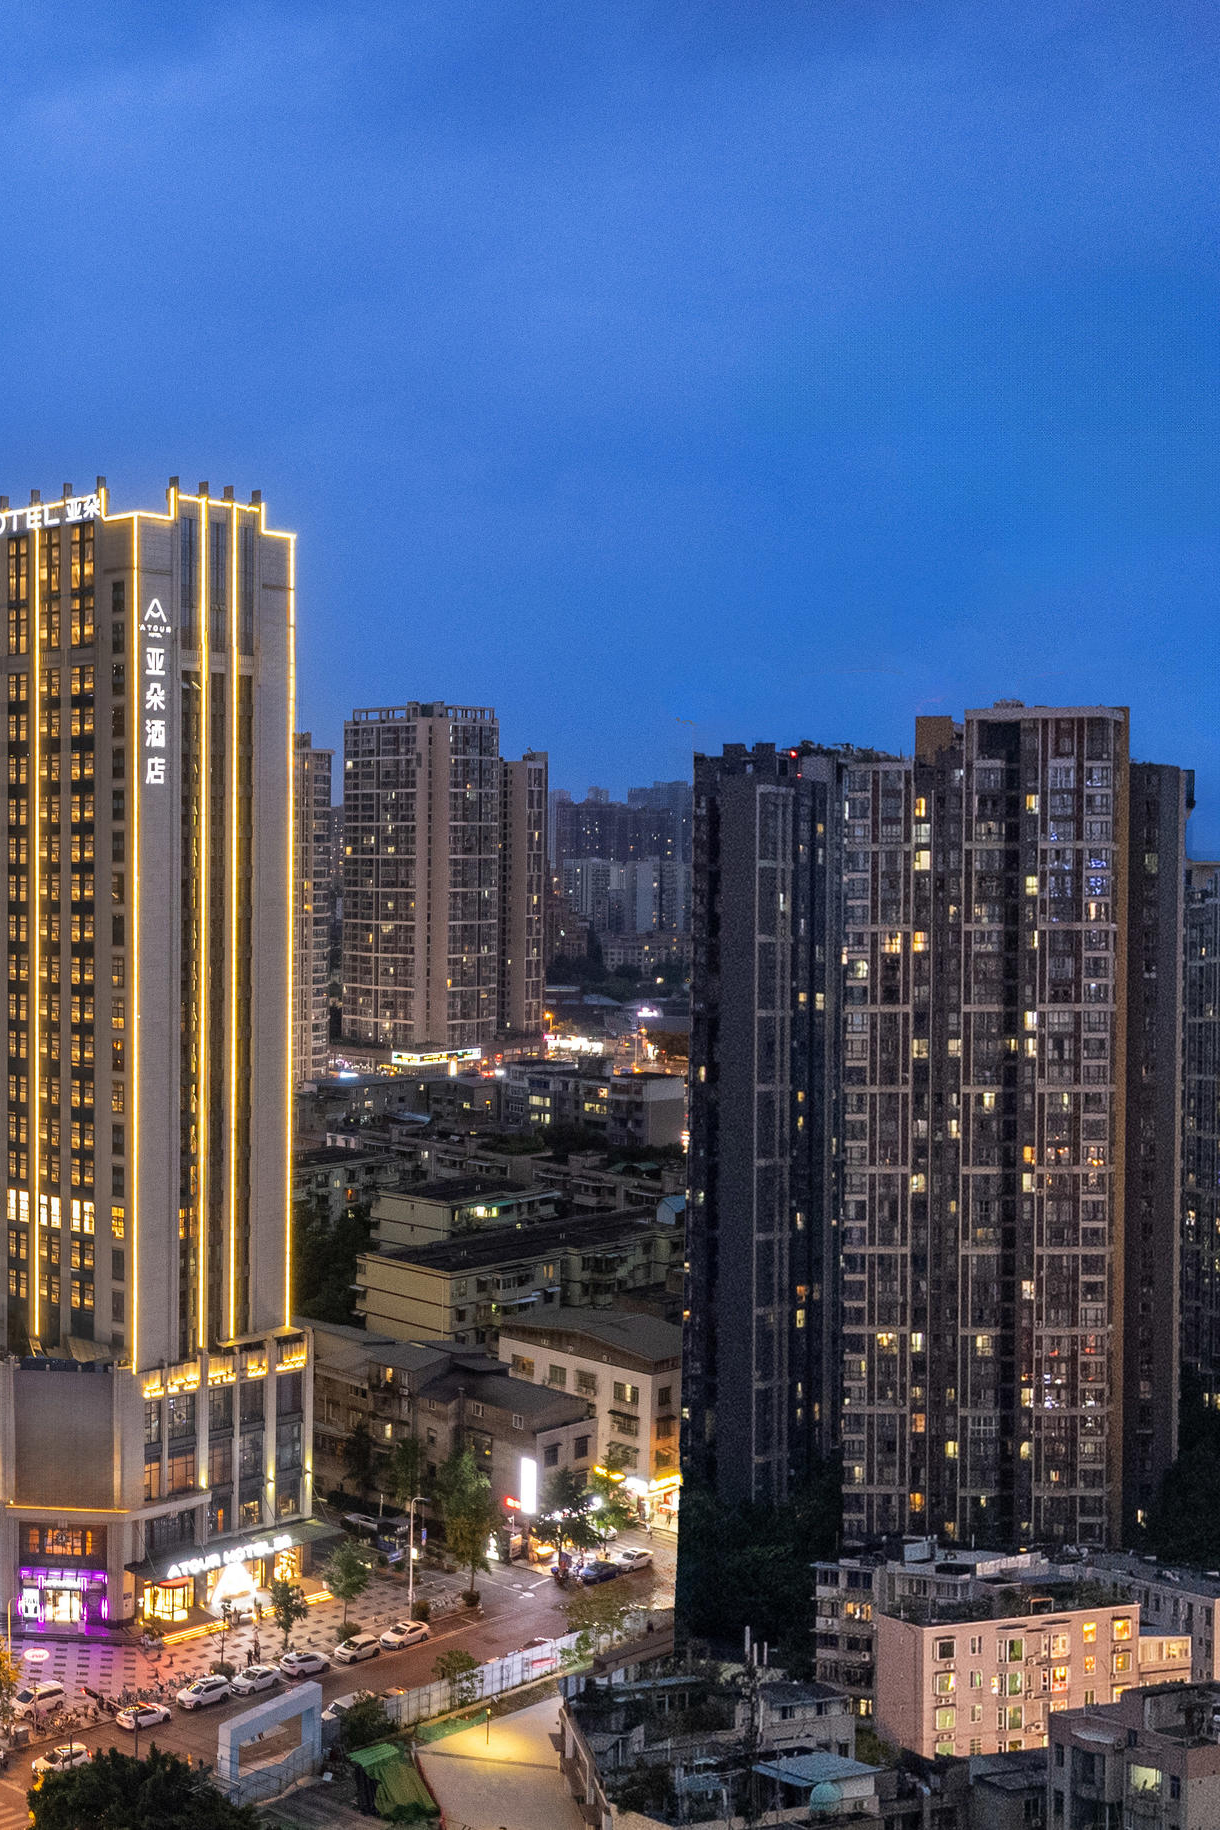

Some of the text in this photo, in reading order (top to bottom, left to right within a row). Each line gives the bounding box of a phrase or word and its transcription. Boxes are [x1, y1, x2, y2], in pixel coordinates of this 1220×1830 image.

[65, 494, 101, 525] 亚朵
[140, 623, 172, 634] ATOUR
[145, 647, 166, 785] 亚朵酒店
